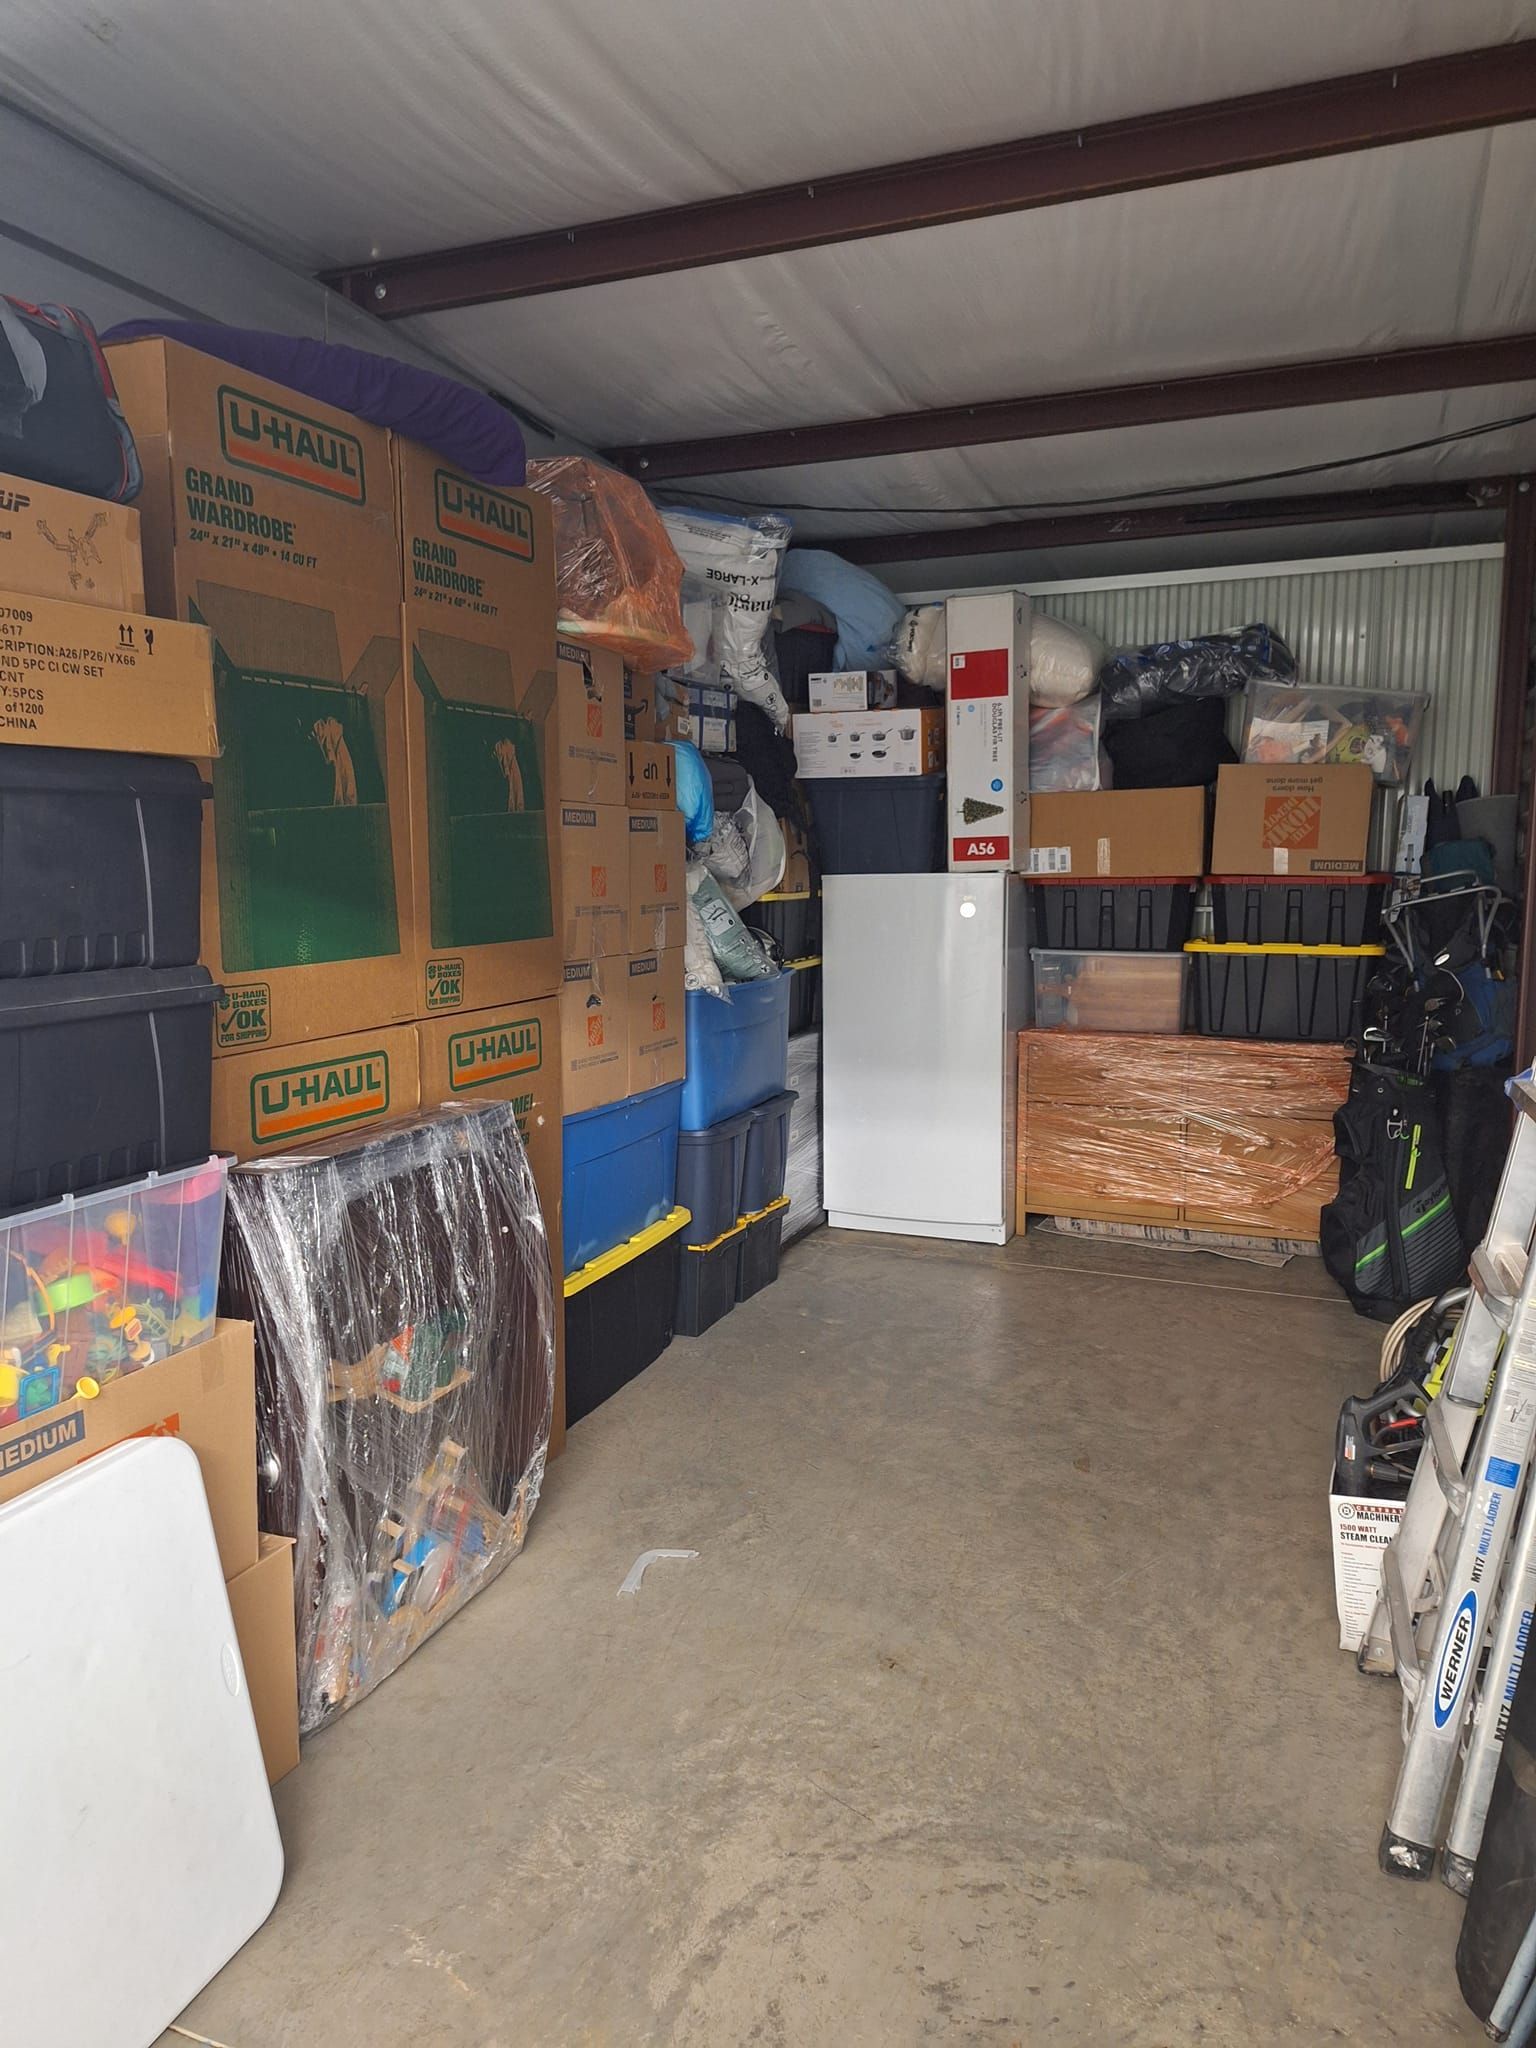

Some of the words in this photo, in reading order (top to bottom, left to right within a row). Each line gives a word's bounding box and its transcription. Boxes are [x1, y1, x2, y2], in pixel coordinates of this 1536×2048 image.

[185, 467, 254, 507] GRAND
[187, 496, 295, 545] WARDROBE
[413, 537, 457, 567] GRAND
[306, 556, 318, 569] FT
[413, 560, 483, 597] WARDROBE
[706, 568, 760, 586] X-LARGE
[23, 659, 45, 671] 5PC
[48, 661, 60, 672] CI
[62, 663, 80, 674] CW
[83, 665, 104, 678] SET
[5, 702, 17, 713] of
[20, 703, 44, 715] 1200
[643, 762, 659, 780] UP
[564, 810, 595, 825] MEDIUM
[631, 818, 658, 831] MEDIUM
[967, 842, 996, 856] A56
[1313, 860, 1360, 871] MEDIUM
[437, 970, 461, 979] BOXES
[631, 959, 657, 975] MEDIUM
[232, 989, 267, 1001] U-HAUL
[440, 979, 460, 995] OK
[232, 997, 267, 1009] BOXES
[236, 1009, 266, 1029] OK
[1356, 1511, 1402, 1523] MACHINER
[1484, 1492, 1502, 1528] LADDER
[1340, 1523, 1357, 1533] 1500
[1358, 1525, 1377, 1533] WATT
[1340, 1531, 1368, 1543] STEAM
[1477, 1524, 1492, 1556] MULTI
[1440, 1615, 1471, 1702] WERNER
[1503, 1657, 1522, 1702] MULTI
